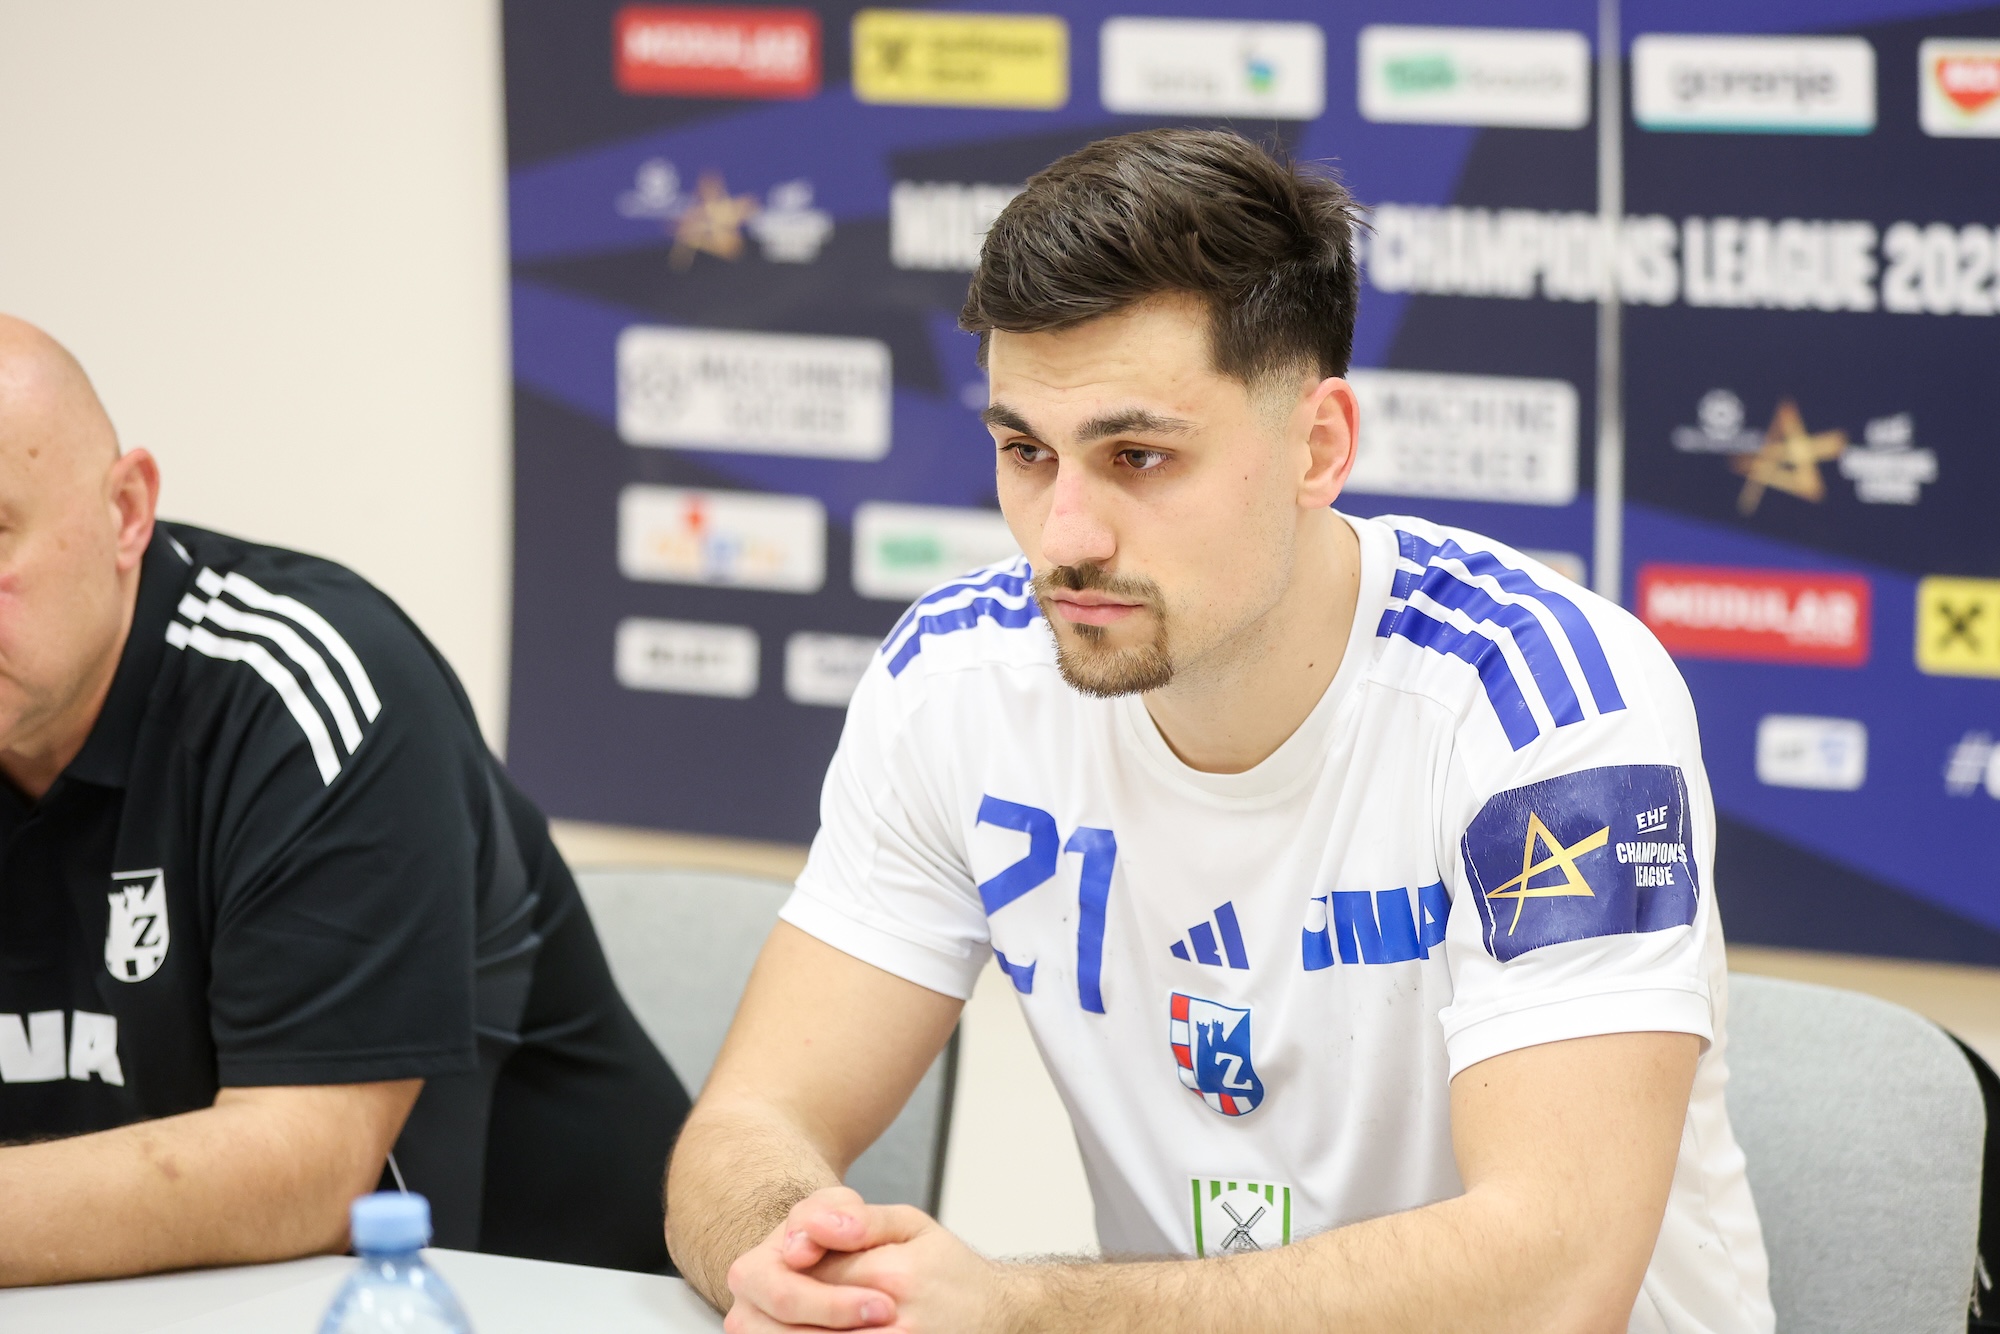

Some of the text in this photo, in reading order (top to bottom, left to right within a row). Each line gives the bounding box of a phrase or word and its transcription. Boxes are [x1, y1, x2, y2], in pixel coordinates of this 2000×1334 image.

[1369, 203, 1680, 305] CHAMPIONS
[1683, 214, 1878, 312] LEAGUE
[1882, 219, 2000, 317] 202
[1636, 805, 1668, 830] EHF
[1615, 841, 1688, 864] CHAMPIONS
[1635, 865, 1675, 887] LEAGUE
[976, 793, 1118, 1015] 21
[131, 914, 161, 948] Z
[1214, 1052, 1252, 1090] Z
